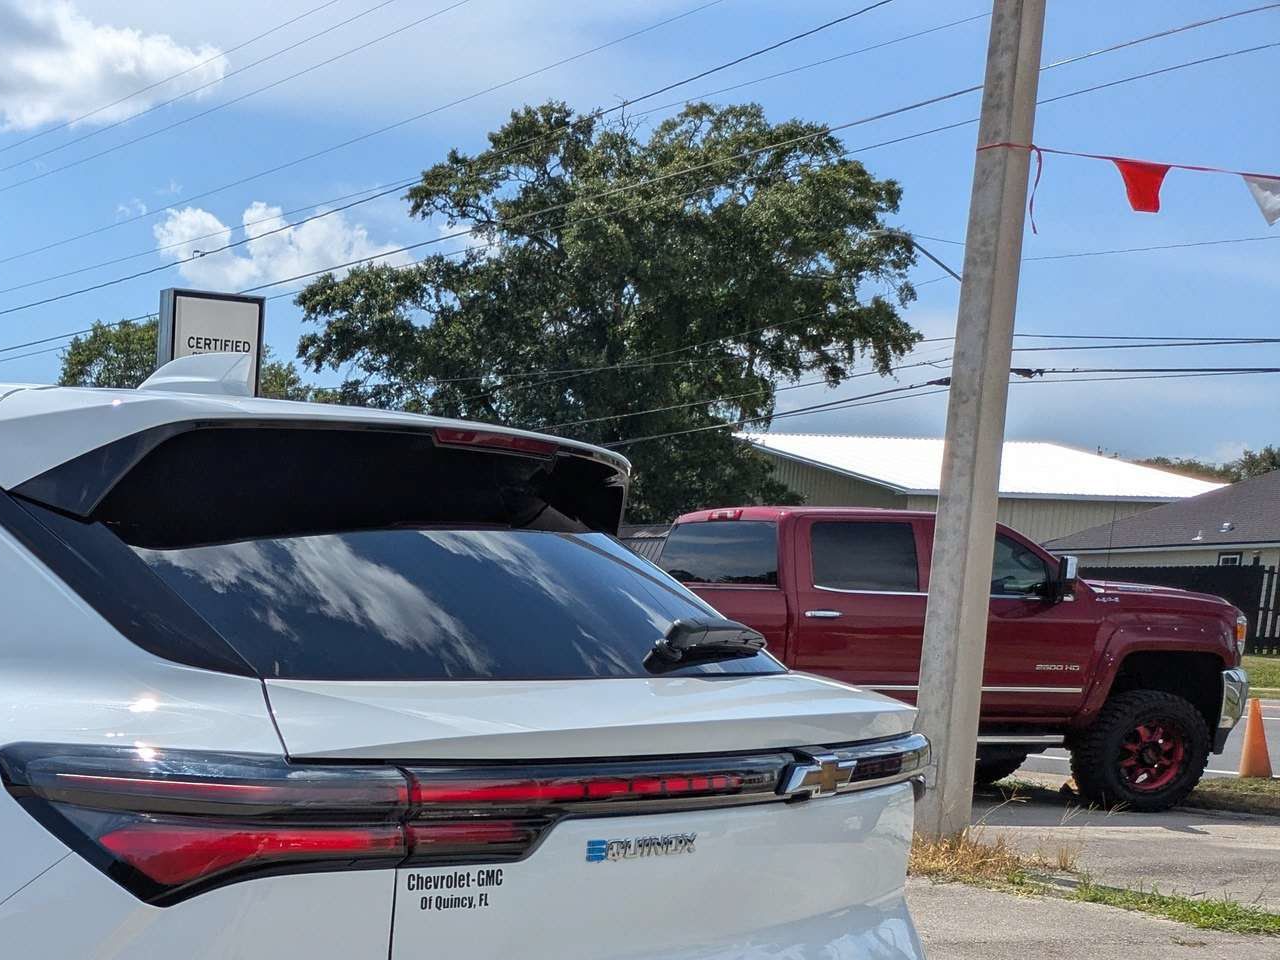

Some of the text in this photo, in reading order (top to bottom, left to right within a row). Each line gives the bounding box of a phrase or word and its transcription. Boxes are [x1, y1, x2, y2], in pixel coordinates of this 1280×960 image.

[187, 336, 251, 353] CERTIFIED
[585, 832, 697, 864] EQUINOX
[407, 868, 504, 891] Chevrolet-GMC
[420, 892, 490, 911] Of Quincy, FL
